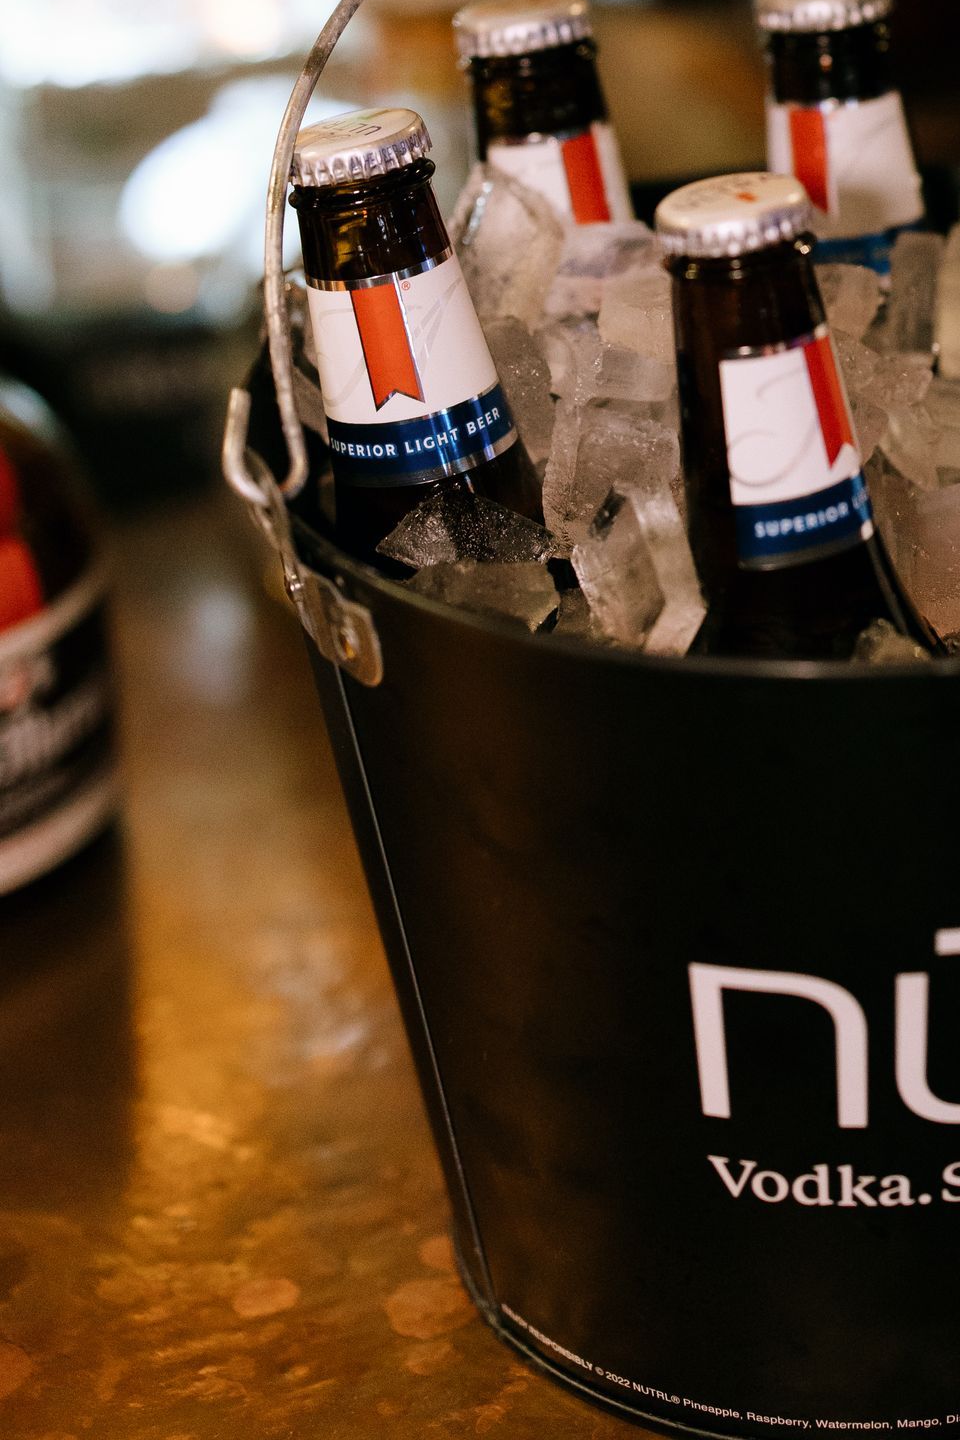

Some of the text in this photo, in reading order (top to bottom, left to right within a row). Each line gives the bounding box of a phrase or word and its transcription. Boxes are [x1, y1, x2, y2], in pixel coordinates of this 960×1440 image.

[330, 407, 501, 457] SUPERIOR LIGHT BEER
[754, 501, 849, 538] SUPERIOR
[706, 1154, 932, 1208] Vodka.
[605, 1371, 631, 1389] 2022
[682, 1397, 743, 1421] Pineapple,
[746, 1411, 812, 1430] Raspberry,
[815, 1418, 894, 1431] Watermelon,
[896, 1417, 943, 1430] Mango,
